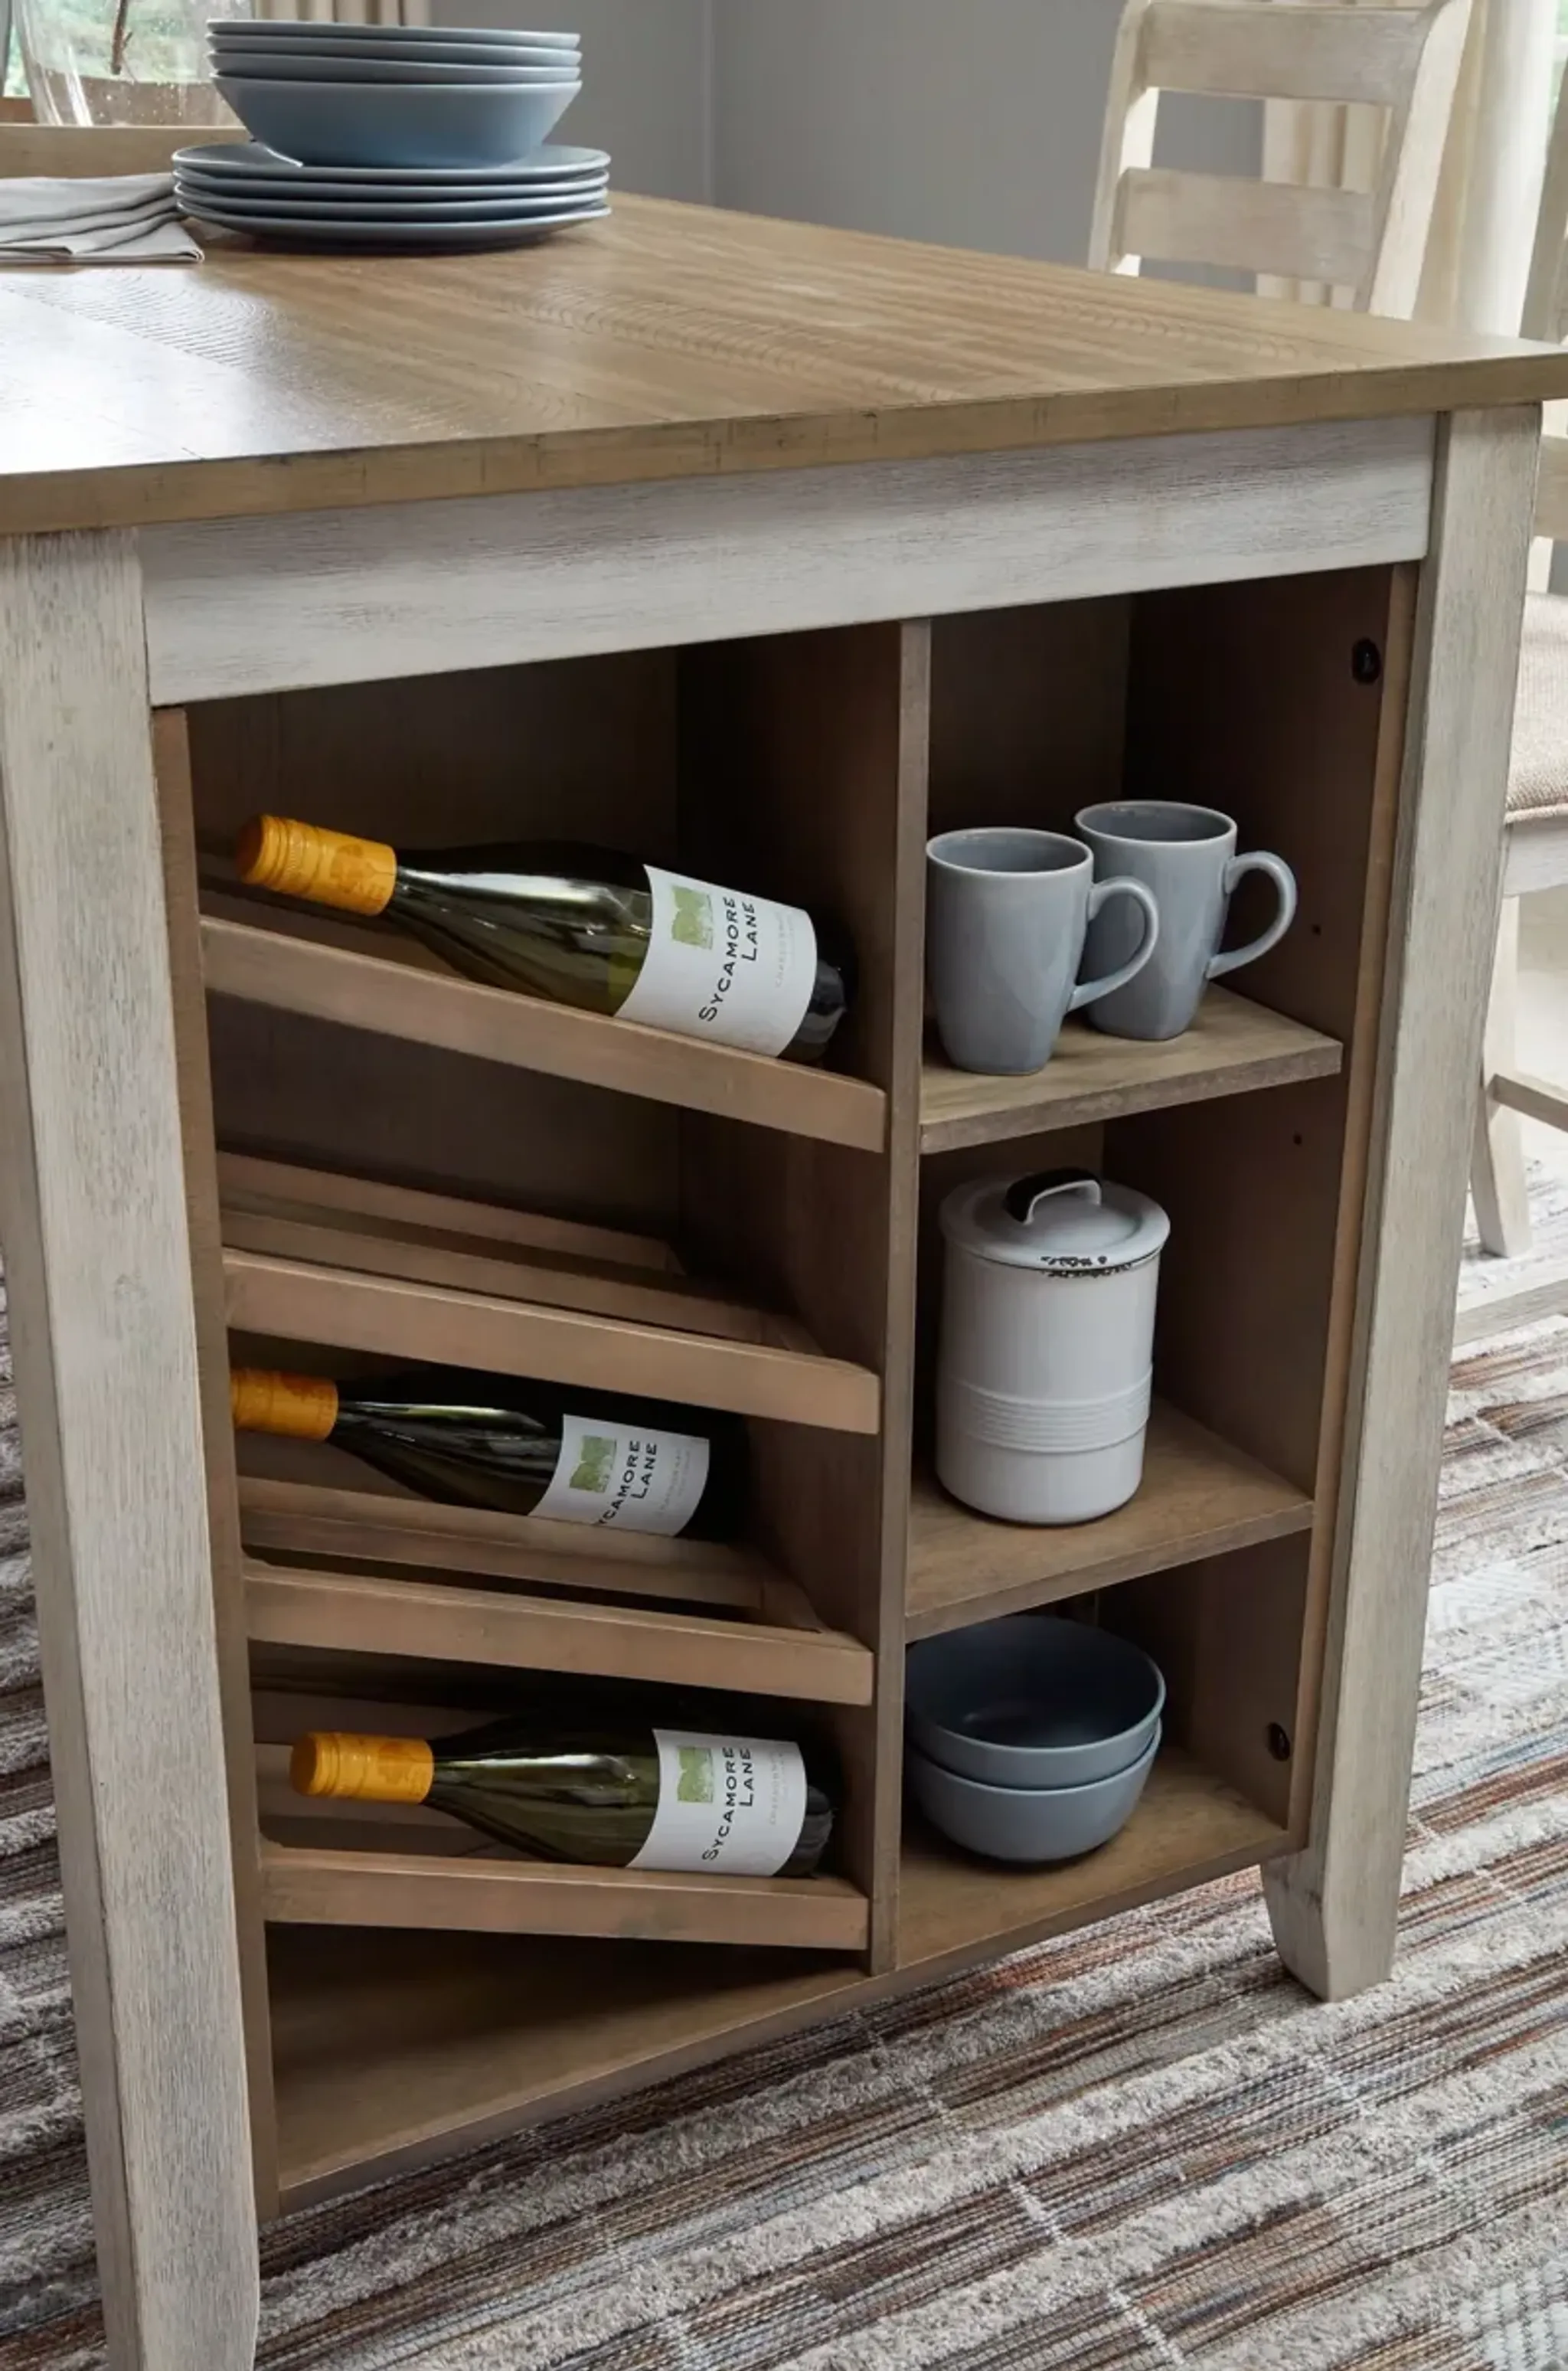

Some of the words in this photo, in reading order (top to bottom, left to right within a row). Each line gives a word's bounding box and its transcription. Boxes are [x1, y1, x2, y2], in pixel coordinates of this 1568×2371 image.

[698, 896, 739, 1022] SYCAMORE
[741, 901, 758, 962] LANE
[598, 1441, 640, 1524] CAMORE
[630, 1442, 658, 1499] LANE
[701, 1746, 737, 1861] SYCAMORE
[739, 1748, 755, 1807] LANE
